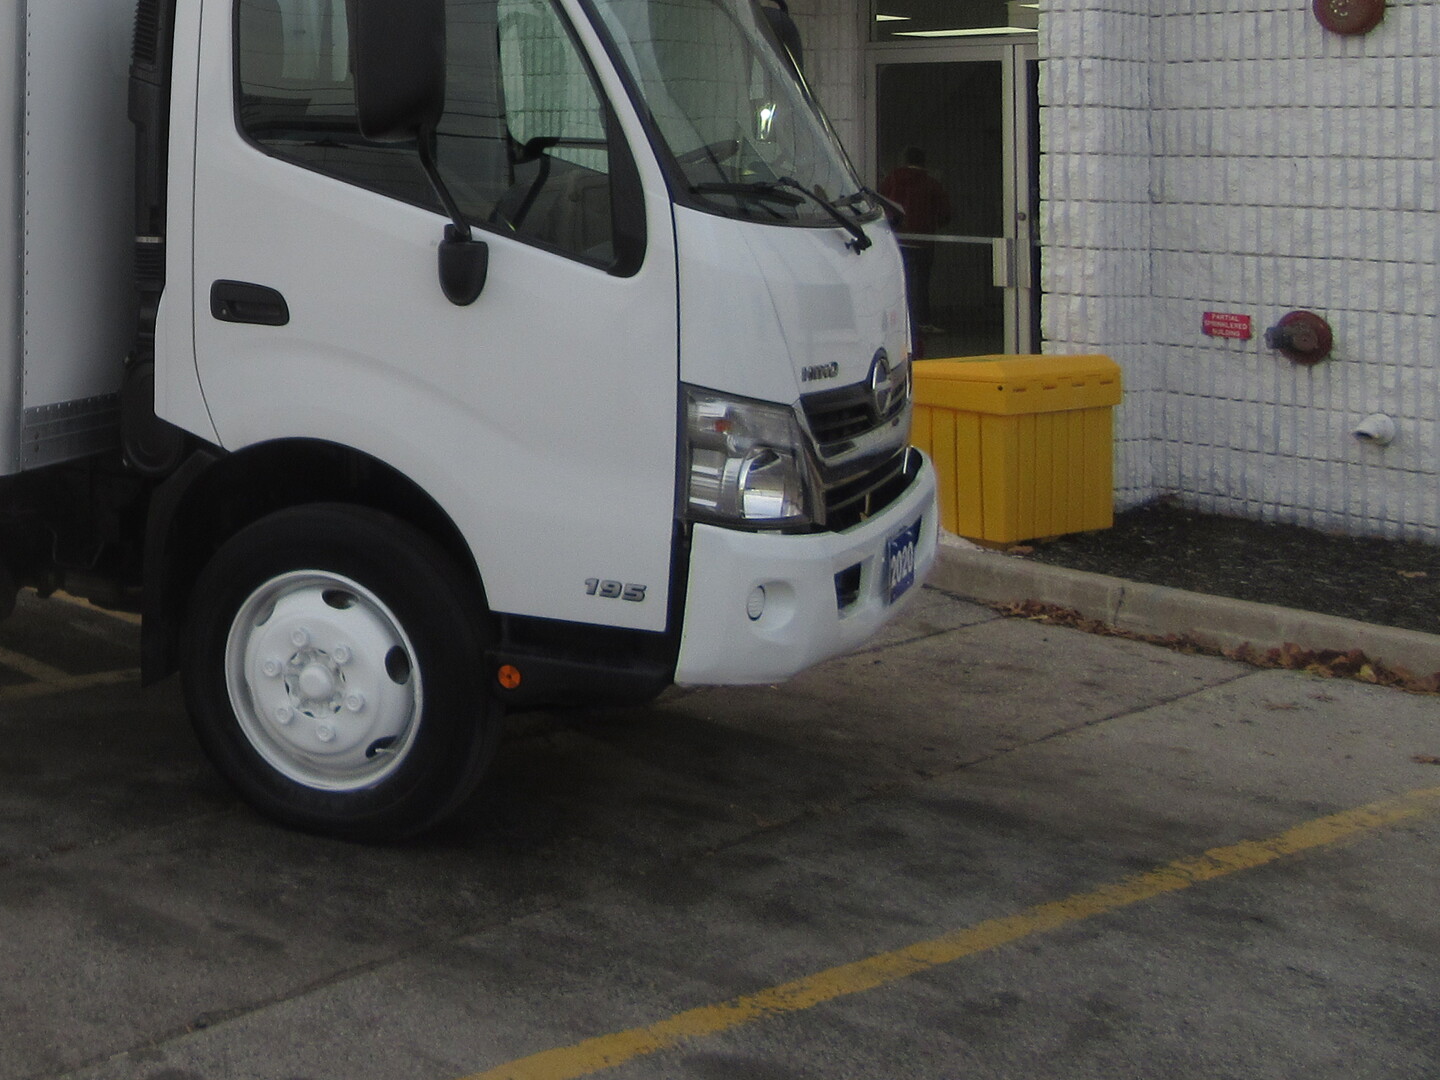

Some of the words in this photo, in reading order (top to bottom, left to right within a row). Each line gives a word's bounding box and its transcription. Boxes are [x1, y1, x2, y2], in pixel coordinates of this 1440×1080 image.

[801, 361, 839, 382] HINO
[891, 540, 914, 587] 2020
[584, 578, 647, 602] 195
